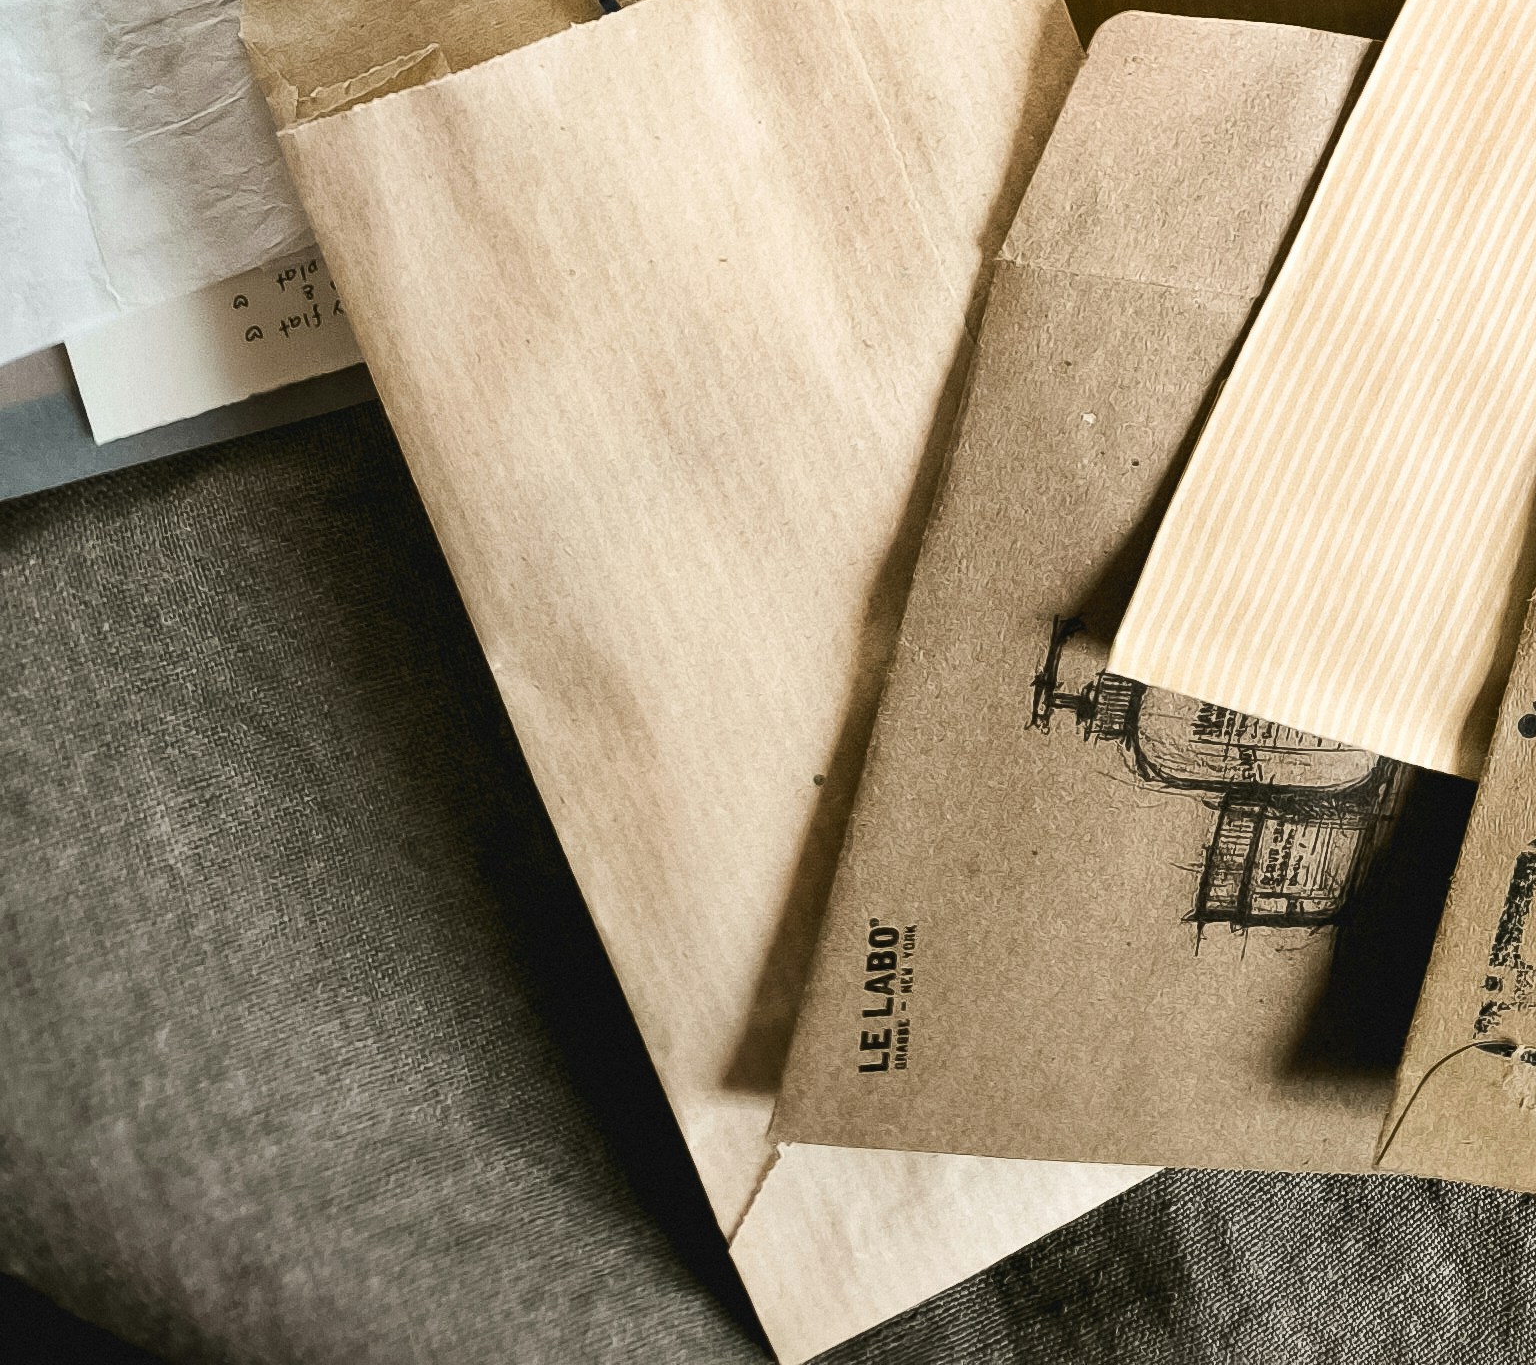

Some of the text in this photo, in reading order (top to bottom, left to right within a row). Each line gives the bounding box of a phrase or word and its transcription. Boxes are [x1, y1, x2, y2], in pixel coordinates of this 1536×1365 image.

[901, 924, 918, 959] YORK
[858, 925, 900, 1073] LE LABO
